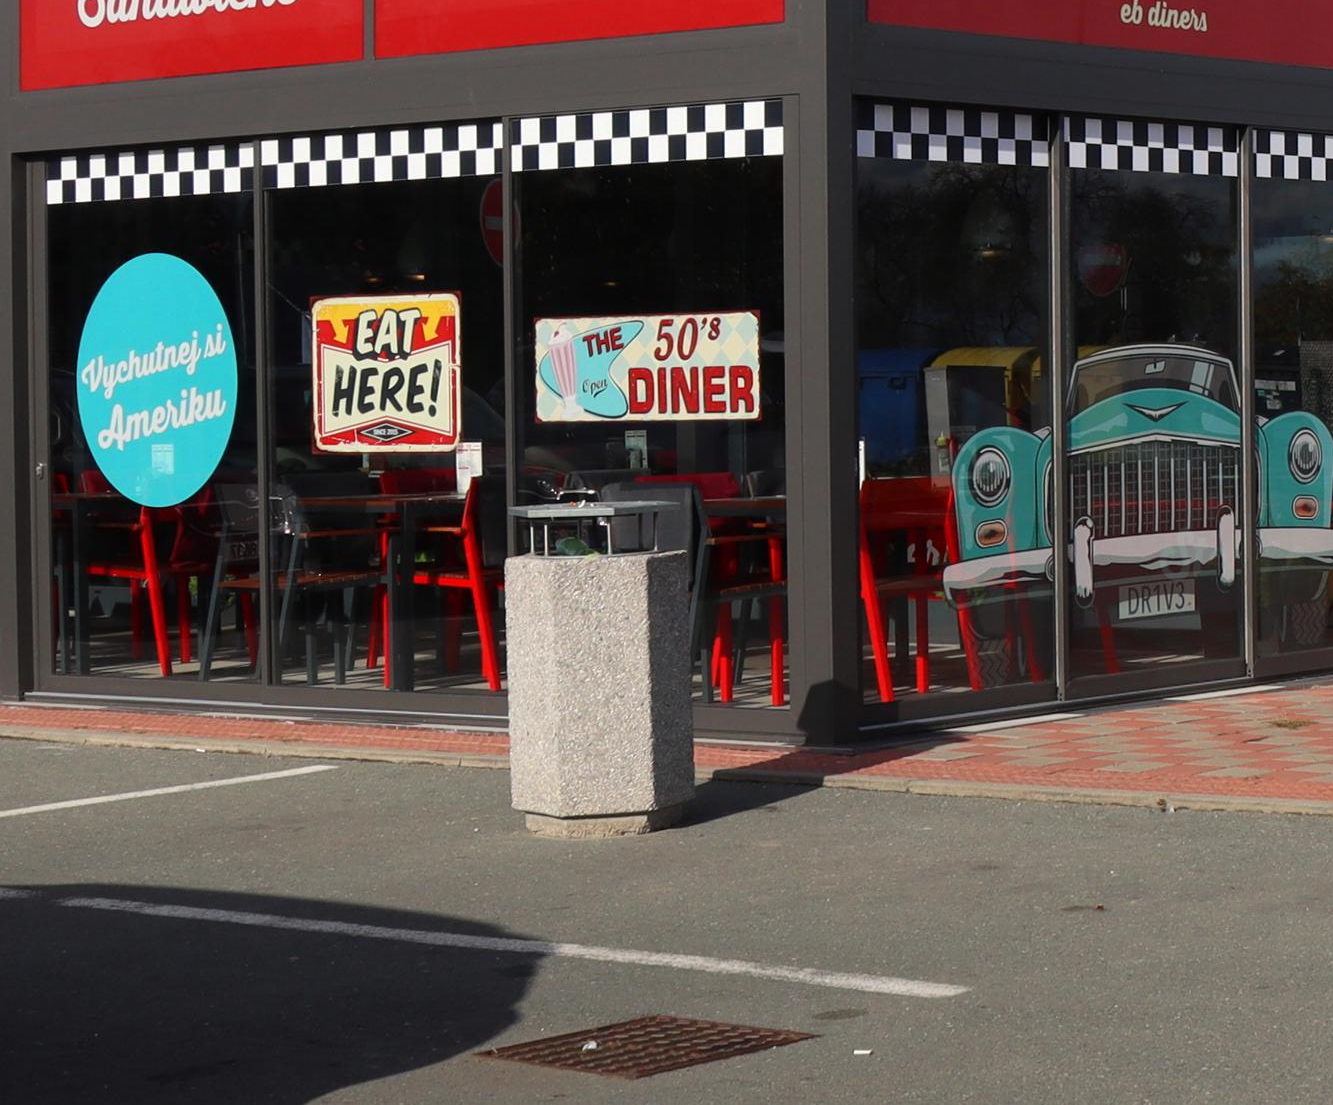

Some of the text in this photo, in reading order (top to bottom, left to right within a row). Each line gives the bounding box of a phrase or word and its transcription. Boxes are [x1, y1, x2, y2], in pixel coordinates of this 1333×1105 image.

[1147, 0, 1208, 32] diners
[353, 308, 422, 359] EAT
[582, 316, 722, 362] THE 50's
[81, 322, 227, 400] Vychutnej si
[582, 376, 609, 396] Open
[331, 358, 443, 418] HERE!
[627, 365, 755, 415] DINER
[97, 386, 227, 452] Ameriku
[1127, 580, 1186, 616] DR1V3
